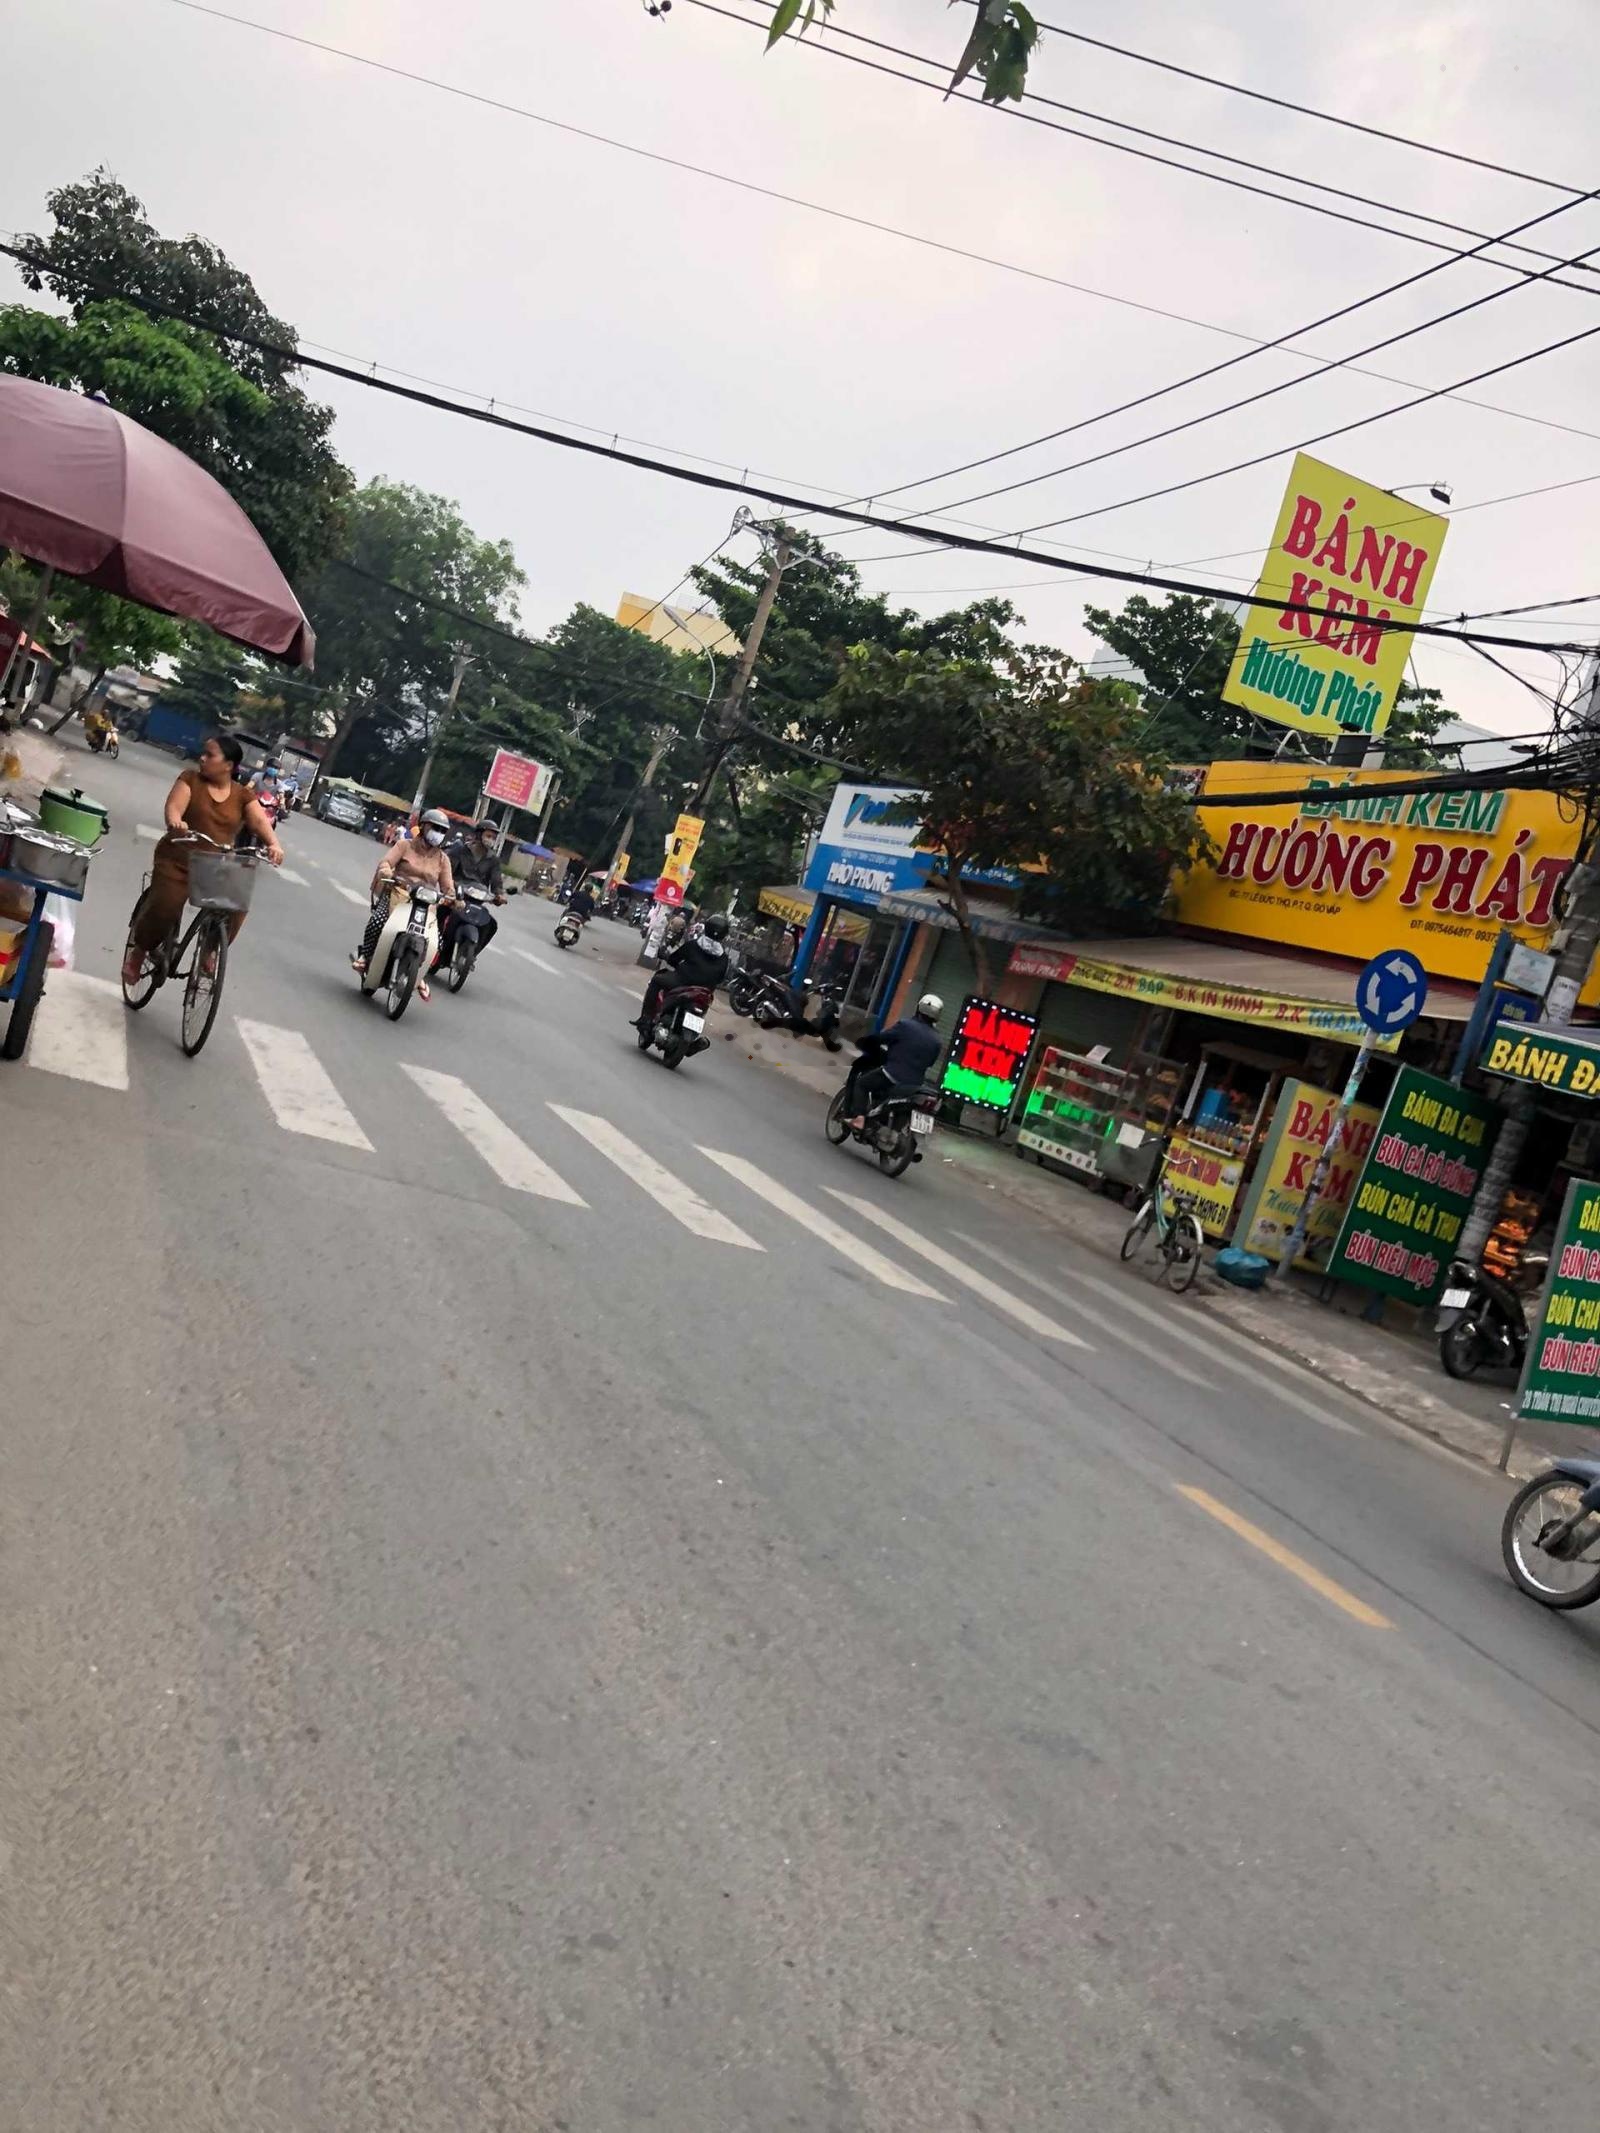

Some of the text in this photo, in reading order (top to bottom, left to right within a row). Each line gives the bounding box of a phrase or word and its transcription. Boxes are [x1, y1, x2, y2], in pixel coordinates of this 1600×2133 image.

[1282, 495, 1428, 605] BÁNH
[1279, 572, 1391, 665] KEM
[1321, 670, 1382, 733] Phát
[1406, 789, 1506, 832] KEM
[1216, 818, 1574, 926] HƯƠNG PHÁT
[1201, 990, 1218, 1006] IN
[1488, 1037, 1568, 1084] BÁNH
[1402, 1090, 1442, 1129] BÁNH
[1374, 1132, 1409, 1170] BÚN
[1283, 1152, 1353, 1203] KM
[1357, 1181, 1391, 1216] BÚN
[1344, 1229, 1380, 1266] BÚN
[1558, 1239, 1590, 1281] BÚN
[1546, 1289, 1576, 1326] BÚN
[1539, 1332, 1574, 1373] BÚN
